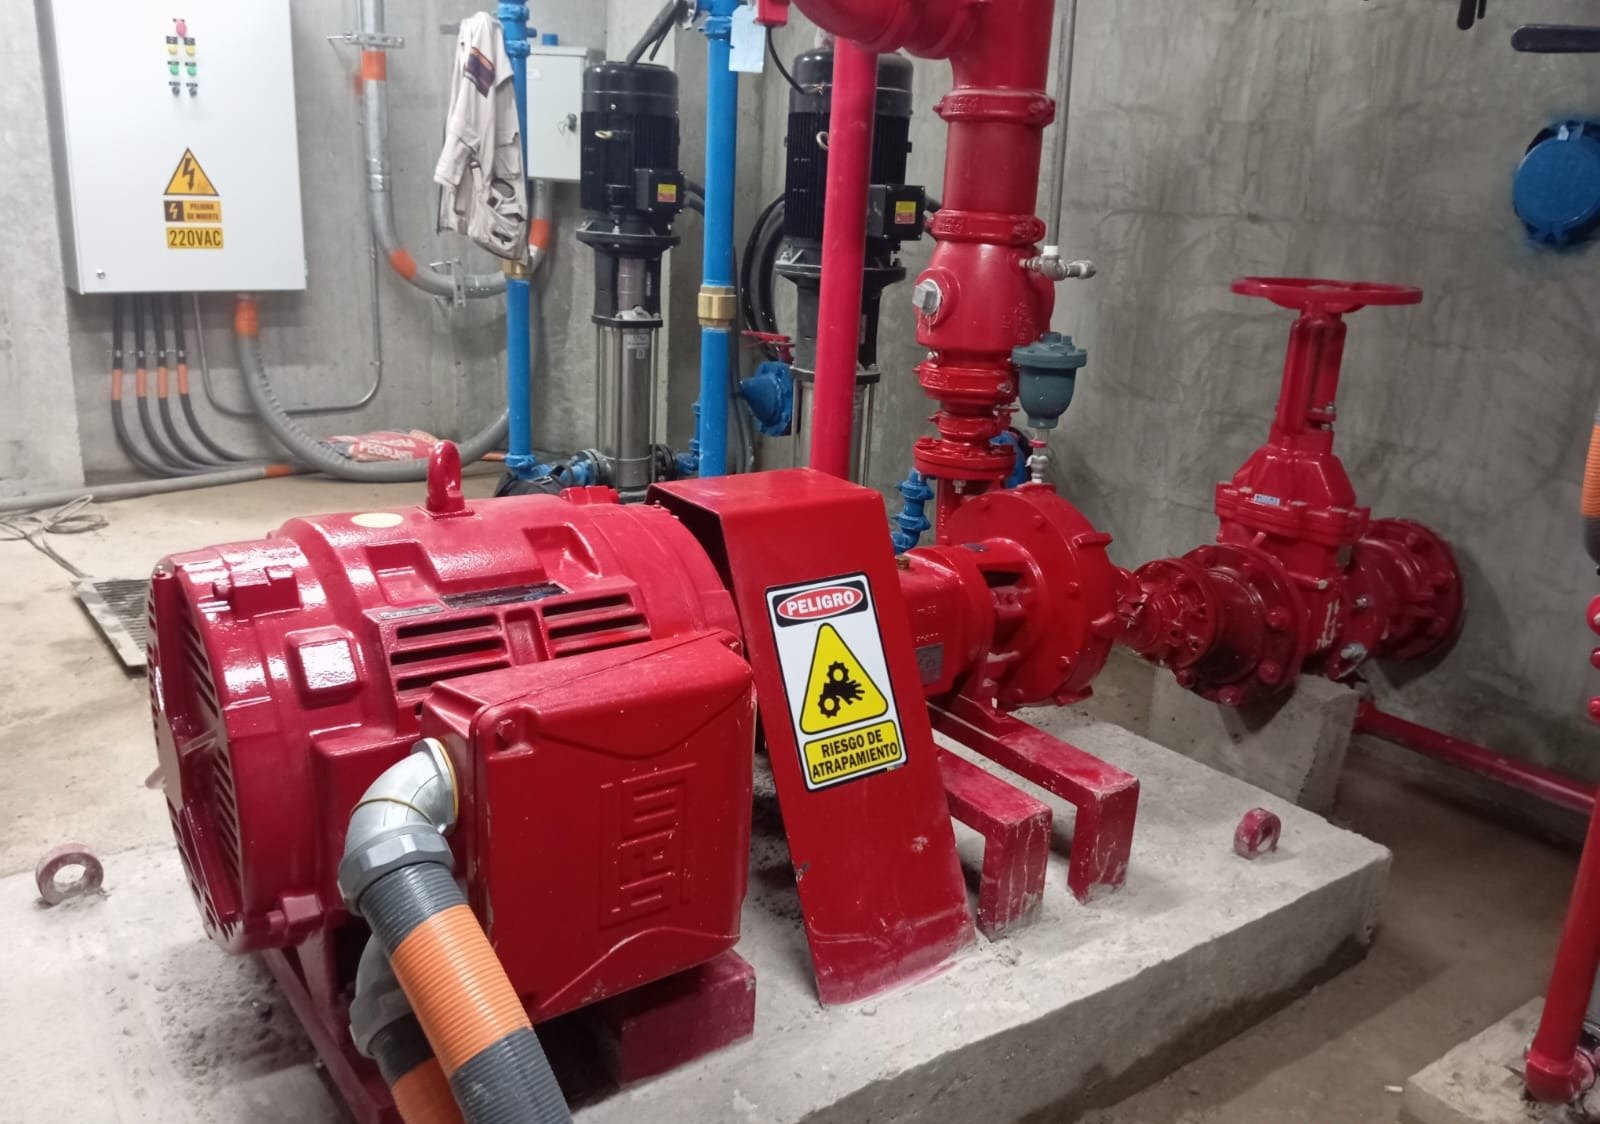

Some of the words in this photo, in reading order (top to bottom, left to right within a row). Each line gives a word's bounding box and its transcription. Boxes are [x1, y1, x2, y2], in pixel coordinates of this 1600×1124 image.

[169, 230, 222, 247] 220VAC
[786, 590, 855, 617] PELIGRO
[821, 734, 865, 758] RIESGO
[867, 729, 883, 745] DE
[812, 742, 898, 780] ATRAPAMIENTO
